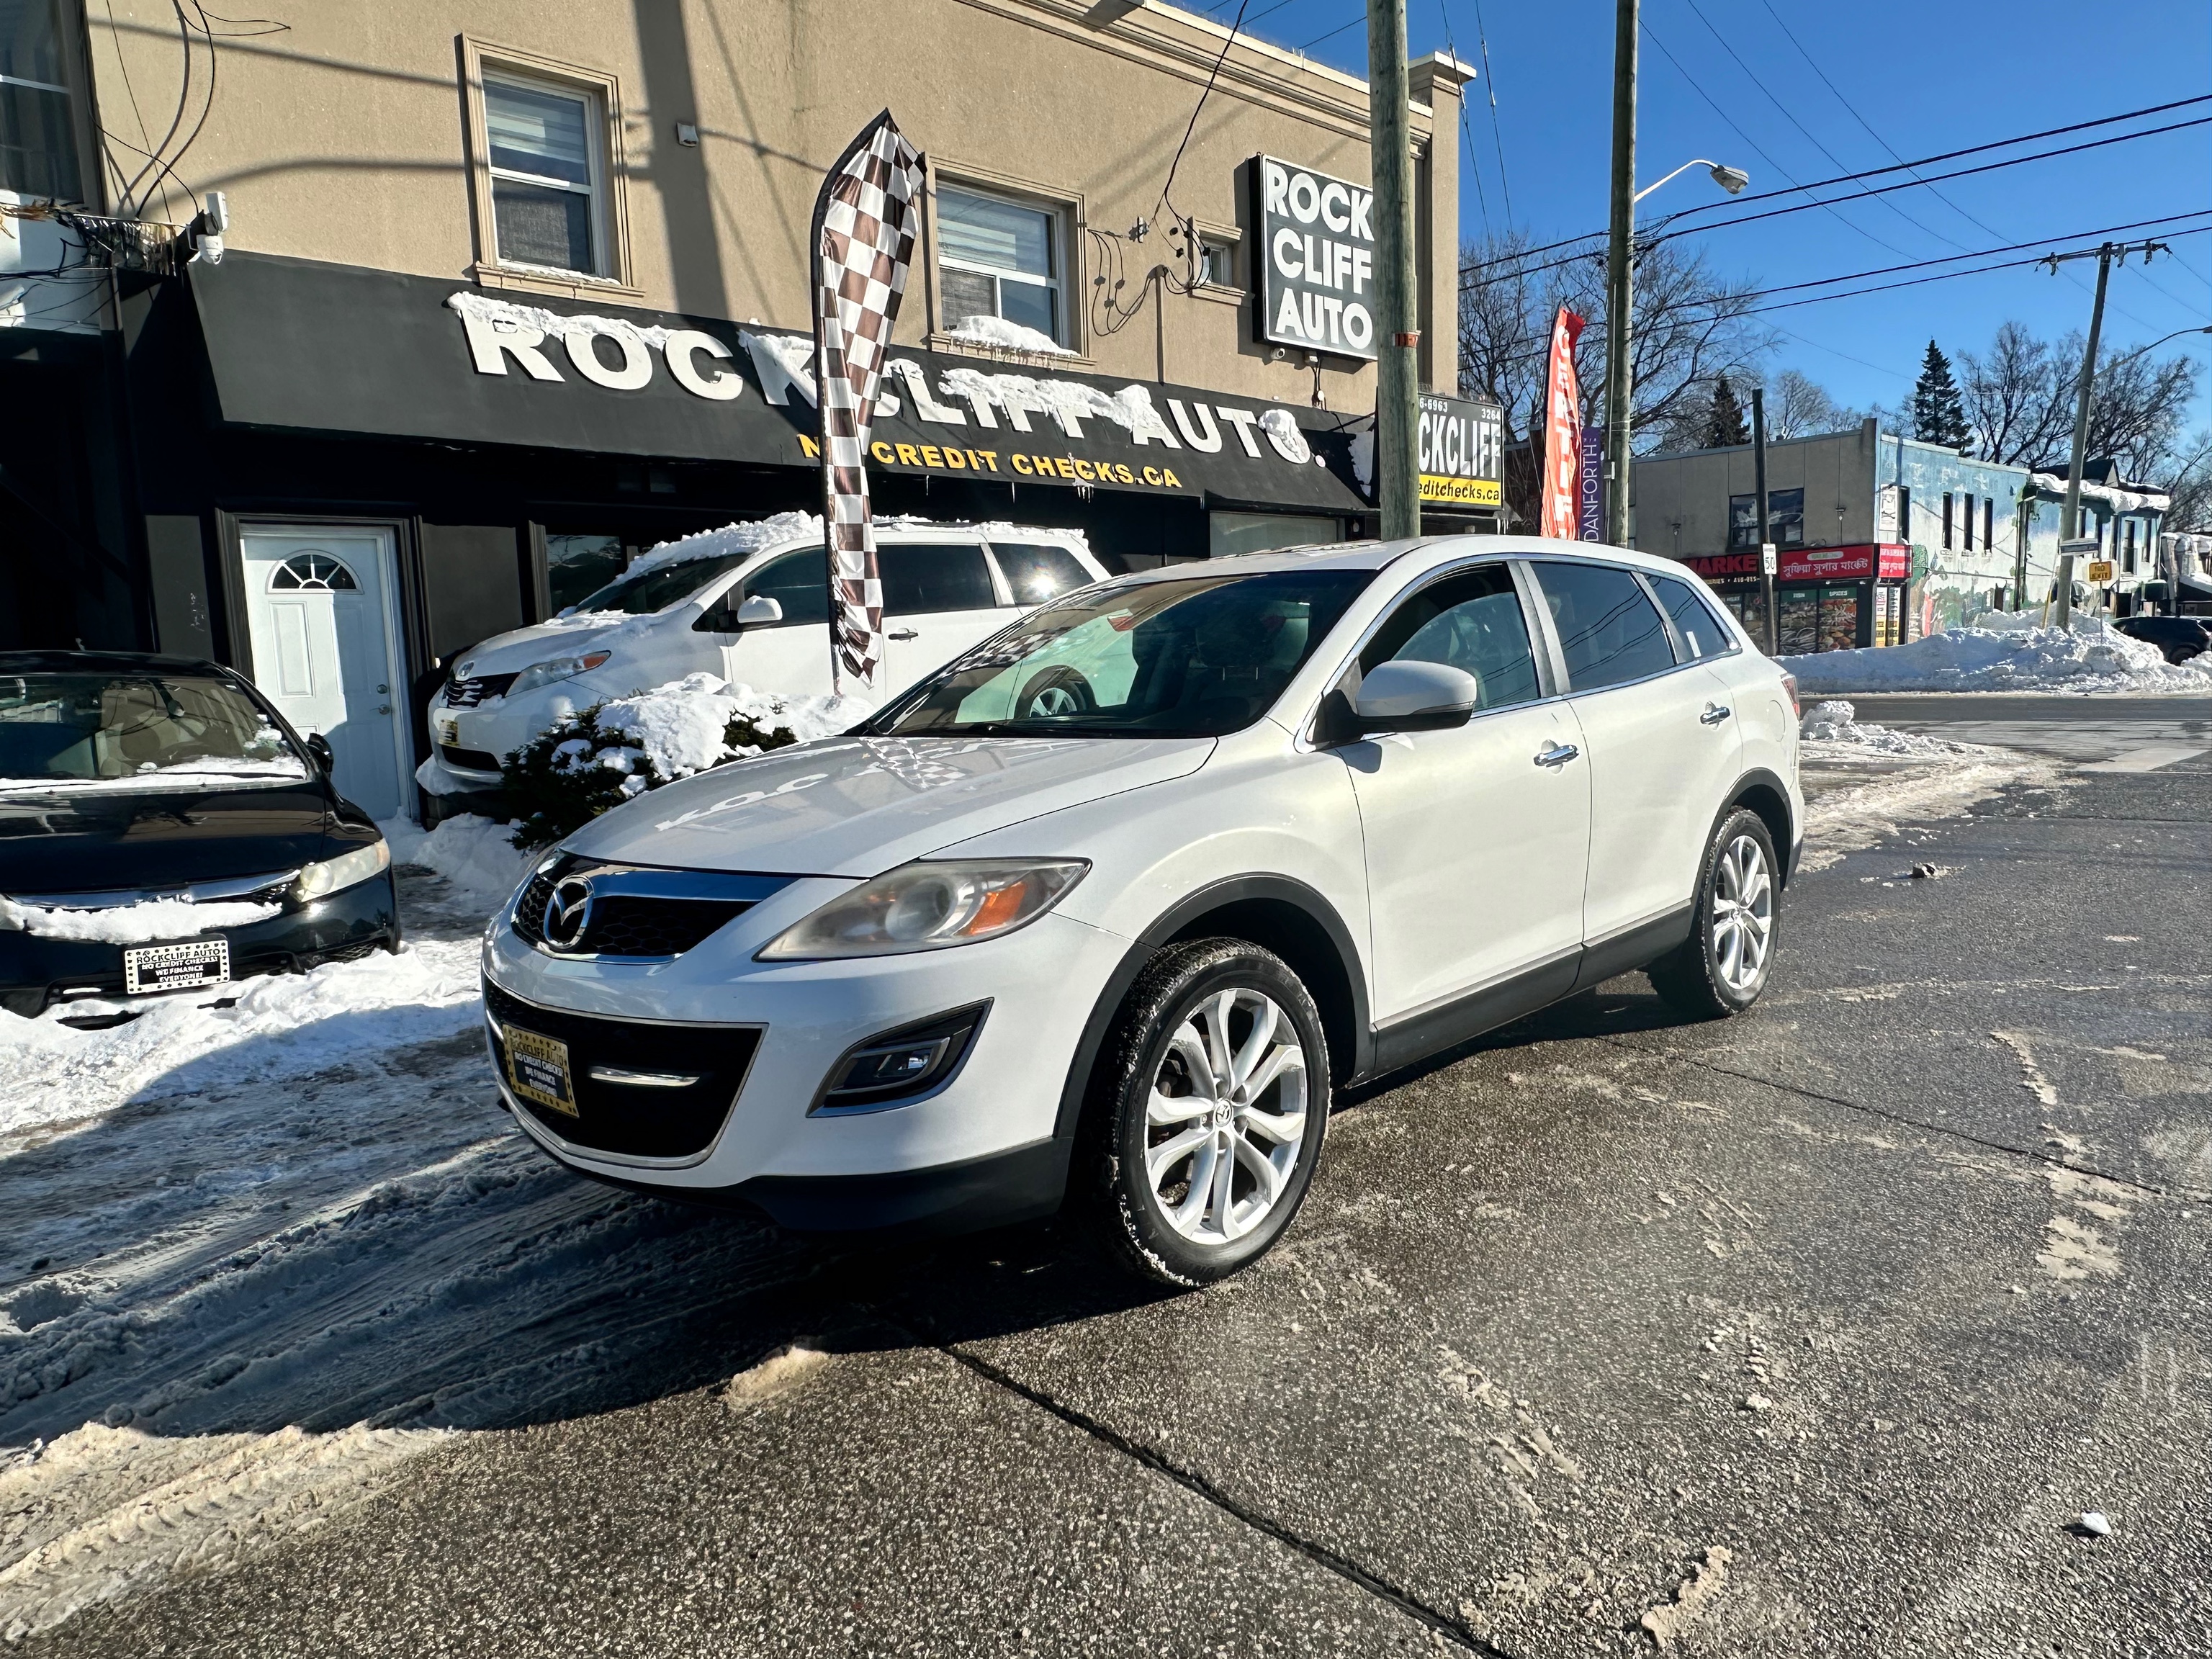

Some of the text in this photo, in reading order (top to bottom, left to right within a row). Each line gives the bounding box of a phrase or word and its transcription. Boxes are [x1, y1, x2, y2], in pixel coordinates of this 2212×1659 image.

[1267, 164, 1375, 241] ROCK
[1273, 227, 1372, 295] CLIFF
[1275, 287, 1373, 350] AUTO
[1419, 397, 1448, 413] 6-6963
[871, 441, 998, 472] CREDIT
[1011, 453, 1182, 488] CHECKS.CA
[1418, 411, 1501, 478] CKCLIFF
[1419, 480, 1499, 500] editchecks.ca
[1582, 443, 1600, 542] DANFORTH
[1685, 554, 1760, 574] MARKE
[1764, 557, 1776, 570] 50
[136, 948, 221, 964] ROCKCLIFF AUTO
